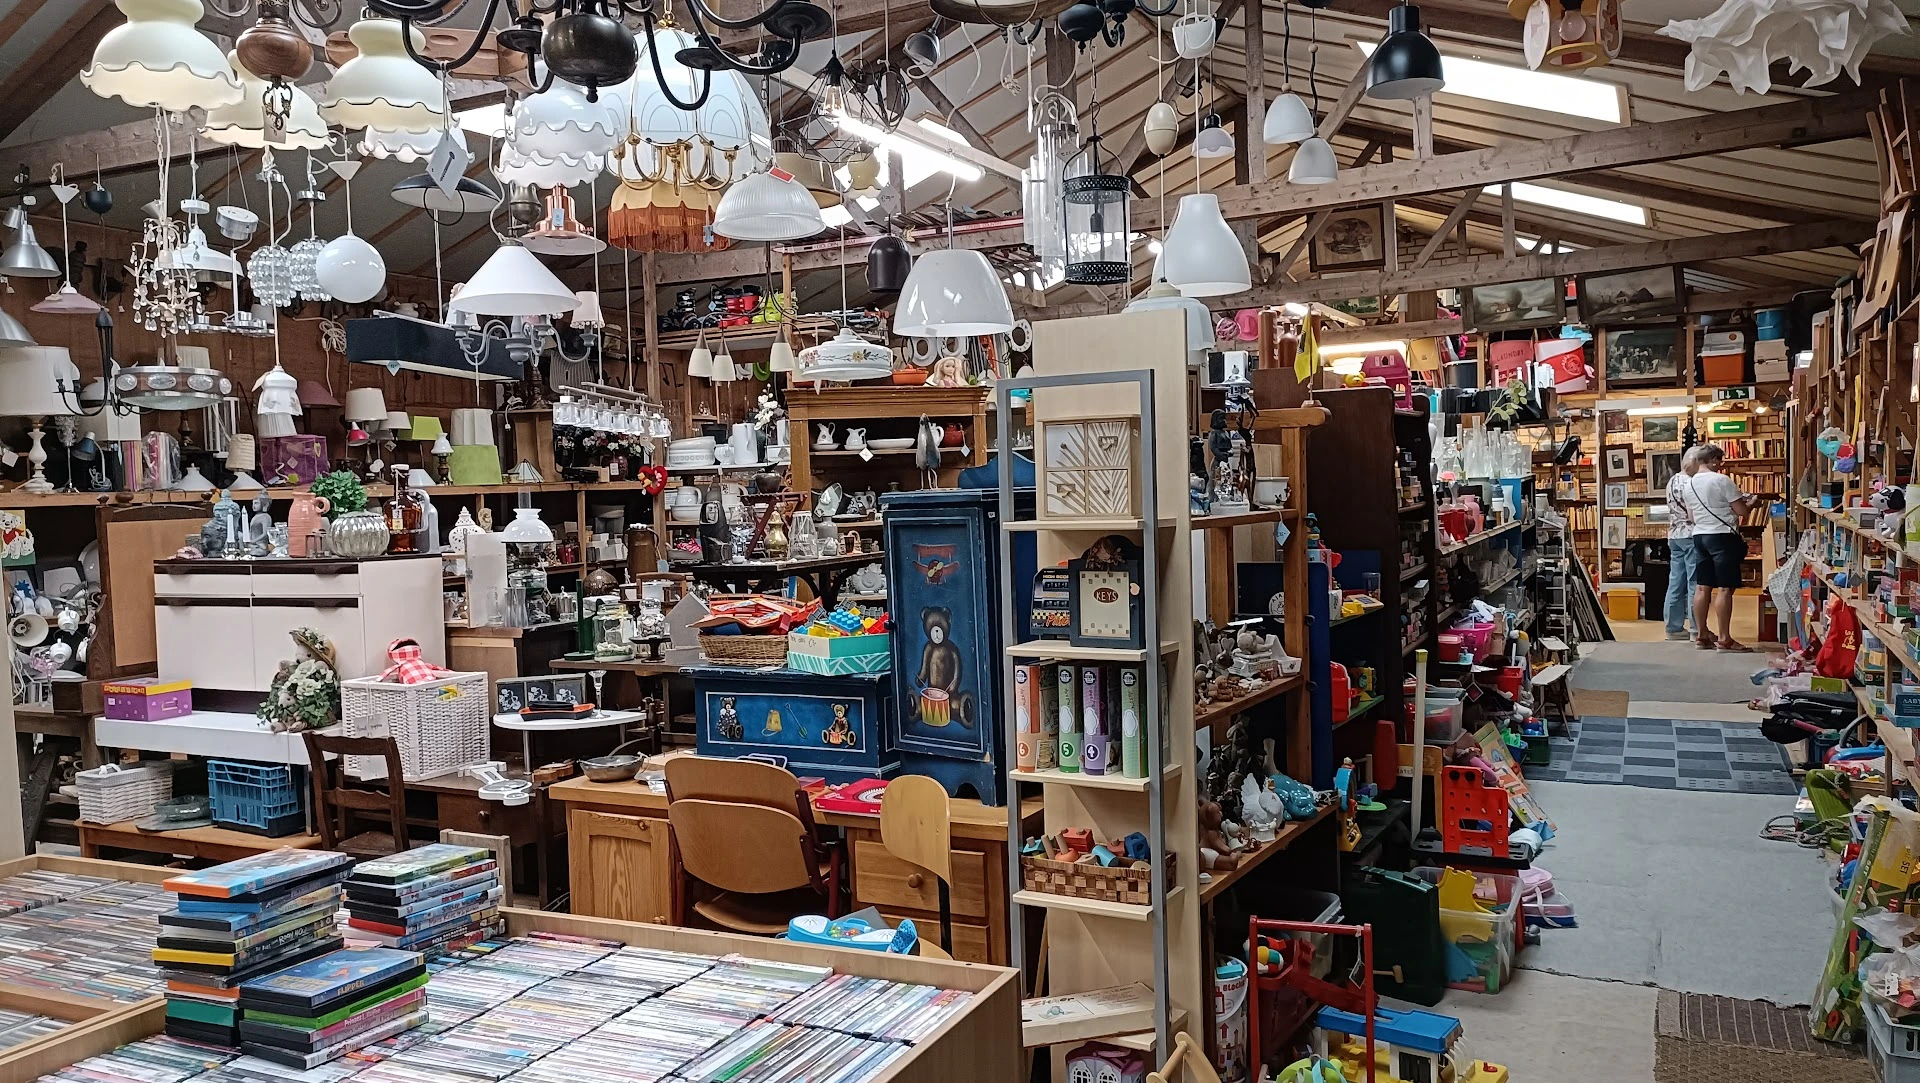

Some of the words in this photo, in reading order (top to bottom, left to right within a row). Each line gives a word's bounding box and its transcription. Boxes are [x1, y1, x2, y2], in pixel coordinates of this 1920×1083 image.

[1497, 349, 1524, 361] LAUNDRY
[1096, 591, 1117, 601] KEYS
[1272, 593, 1283, 602] AJA
[1020, 743, 1025, 754] 6
[1063, 744, 1070, 754] 5
[1088, 746, 1094, 758] 4
[1900, 860, 1910, 875] SET
[337, 980, 366, 996] FLIPPER
